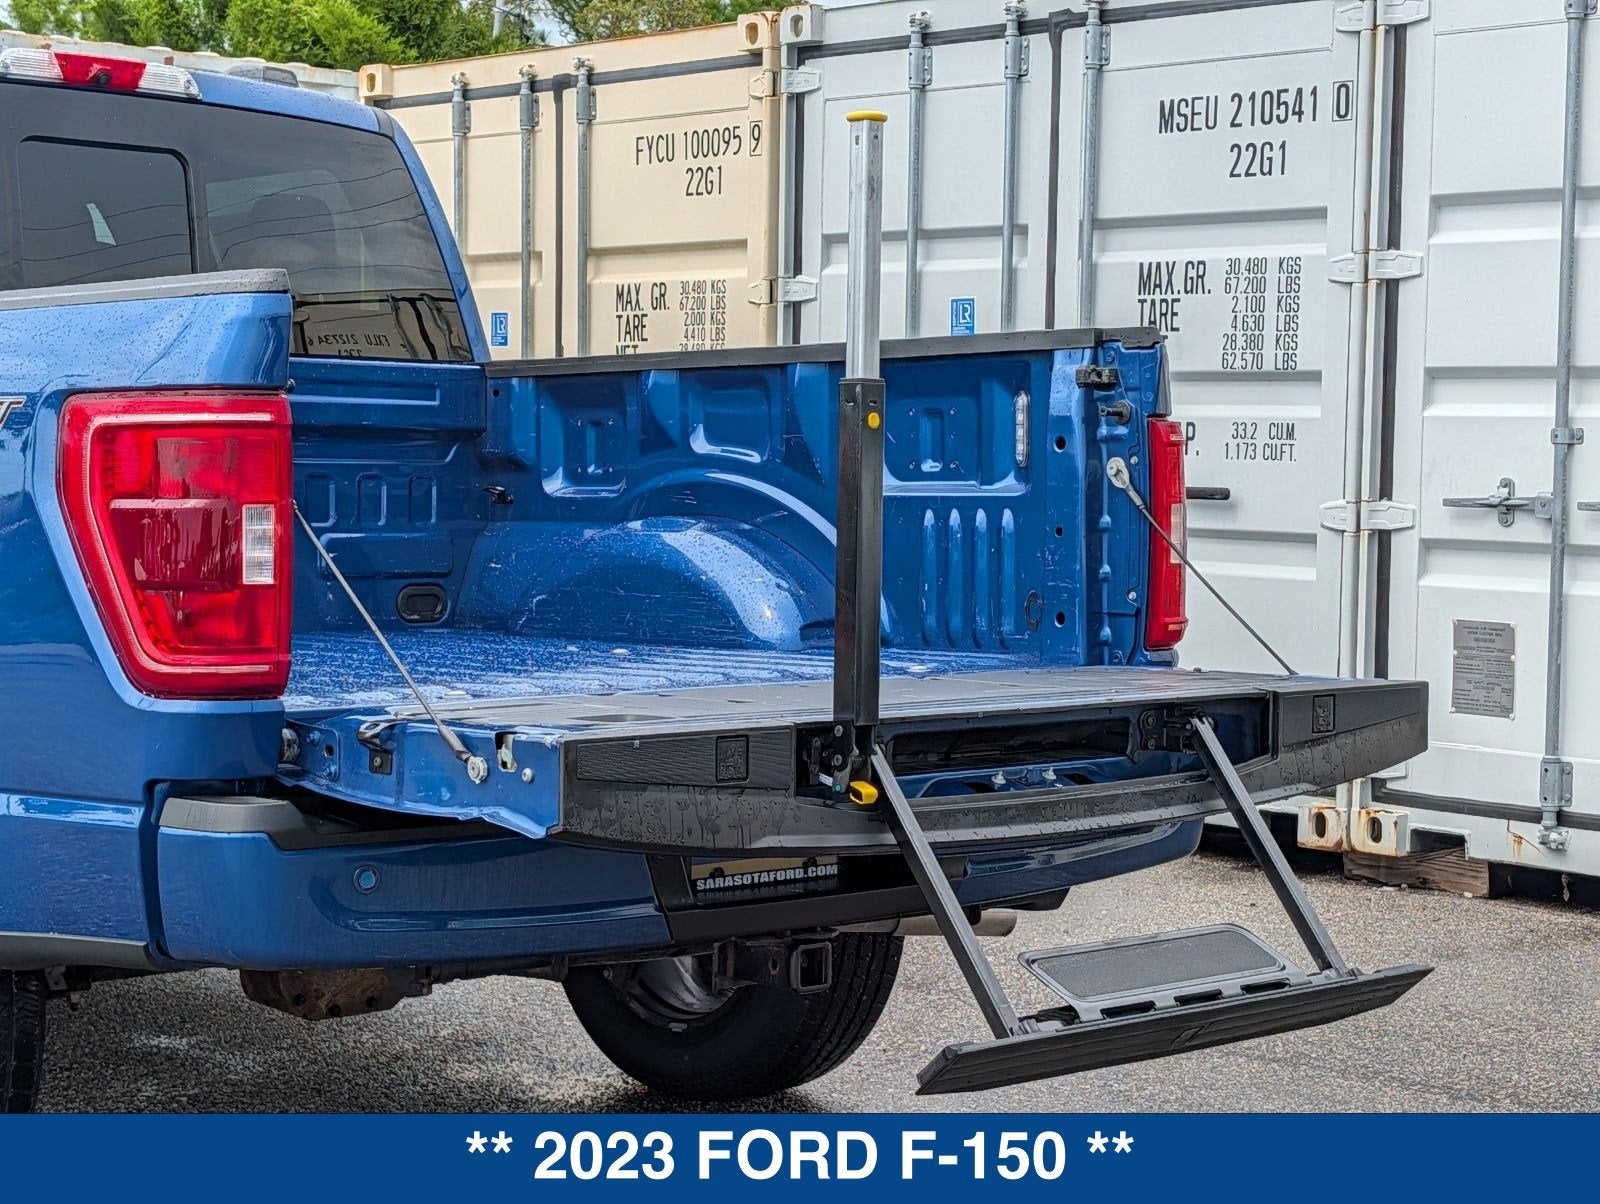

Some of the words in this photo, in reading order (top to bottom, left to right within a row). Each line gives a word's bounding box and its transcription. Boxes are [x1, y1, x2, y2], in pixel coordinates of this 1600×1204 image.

[1158, 95, 1219, 134] MSEU
[1229, 85, 1318, 128] 210541
[1335, 82, 1351, 119] 0
[635, 133, 675, 165] FYCU
[683, 126, 742, 160] 100095
[751, 124, 761, 153] 9
[1229, 140, 1287, 178] 22G1
[685, 165, 723, 196] 22G1
[1278, 256, 1301, 275] KGS
[616, 283, 644, 312] MAX.
[651, 282, 670, 311] GR.
[711, 280, 727, 294] KGS
[1277, 276, 1301, 294] LBS
[710, 295, 727, 310] LBS
[1137, 298, 1181, 332] TARE
[1276, 295, 1300, 313] KGS
[616, 313, 648, 342] TARE
[710, 311, 726, 326] KGS
[710, 326, 726, 342] LBS
[1275, 314, 1299, 332] LBS
[1275, 333, 1298, 351] KGS
[1274, 352, 1297, 370] LBS
[1185, 422, 1199, 456] P.
[1231, 421, 1258, 440] 33.2
[696, 864, 838, 891] SARASOTAFORD.COM
